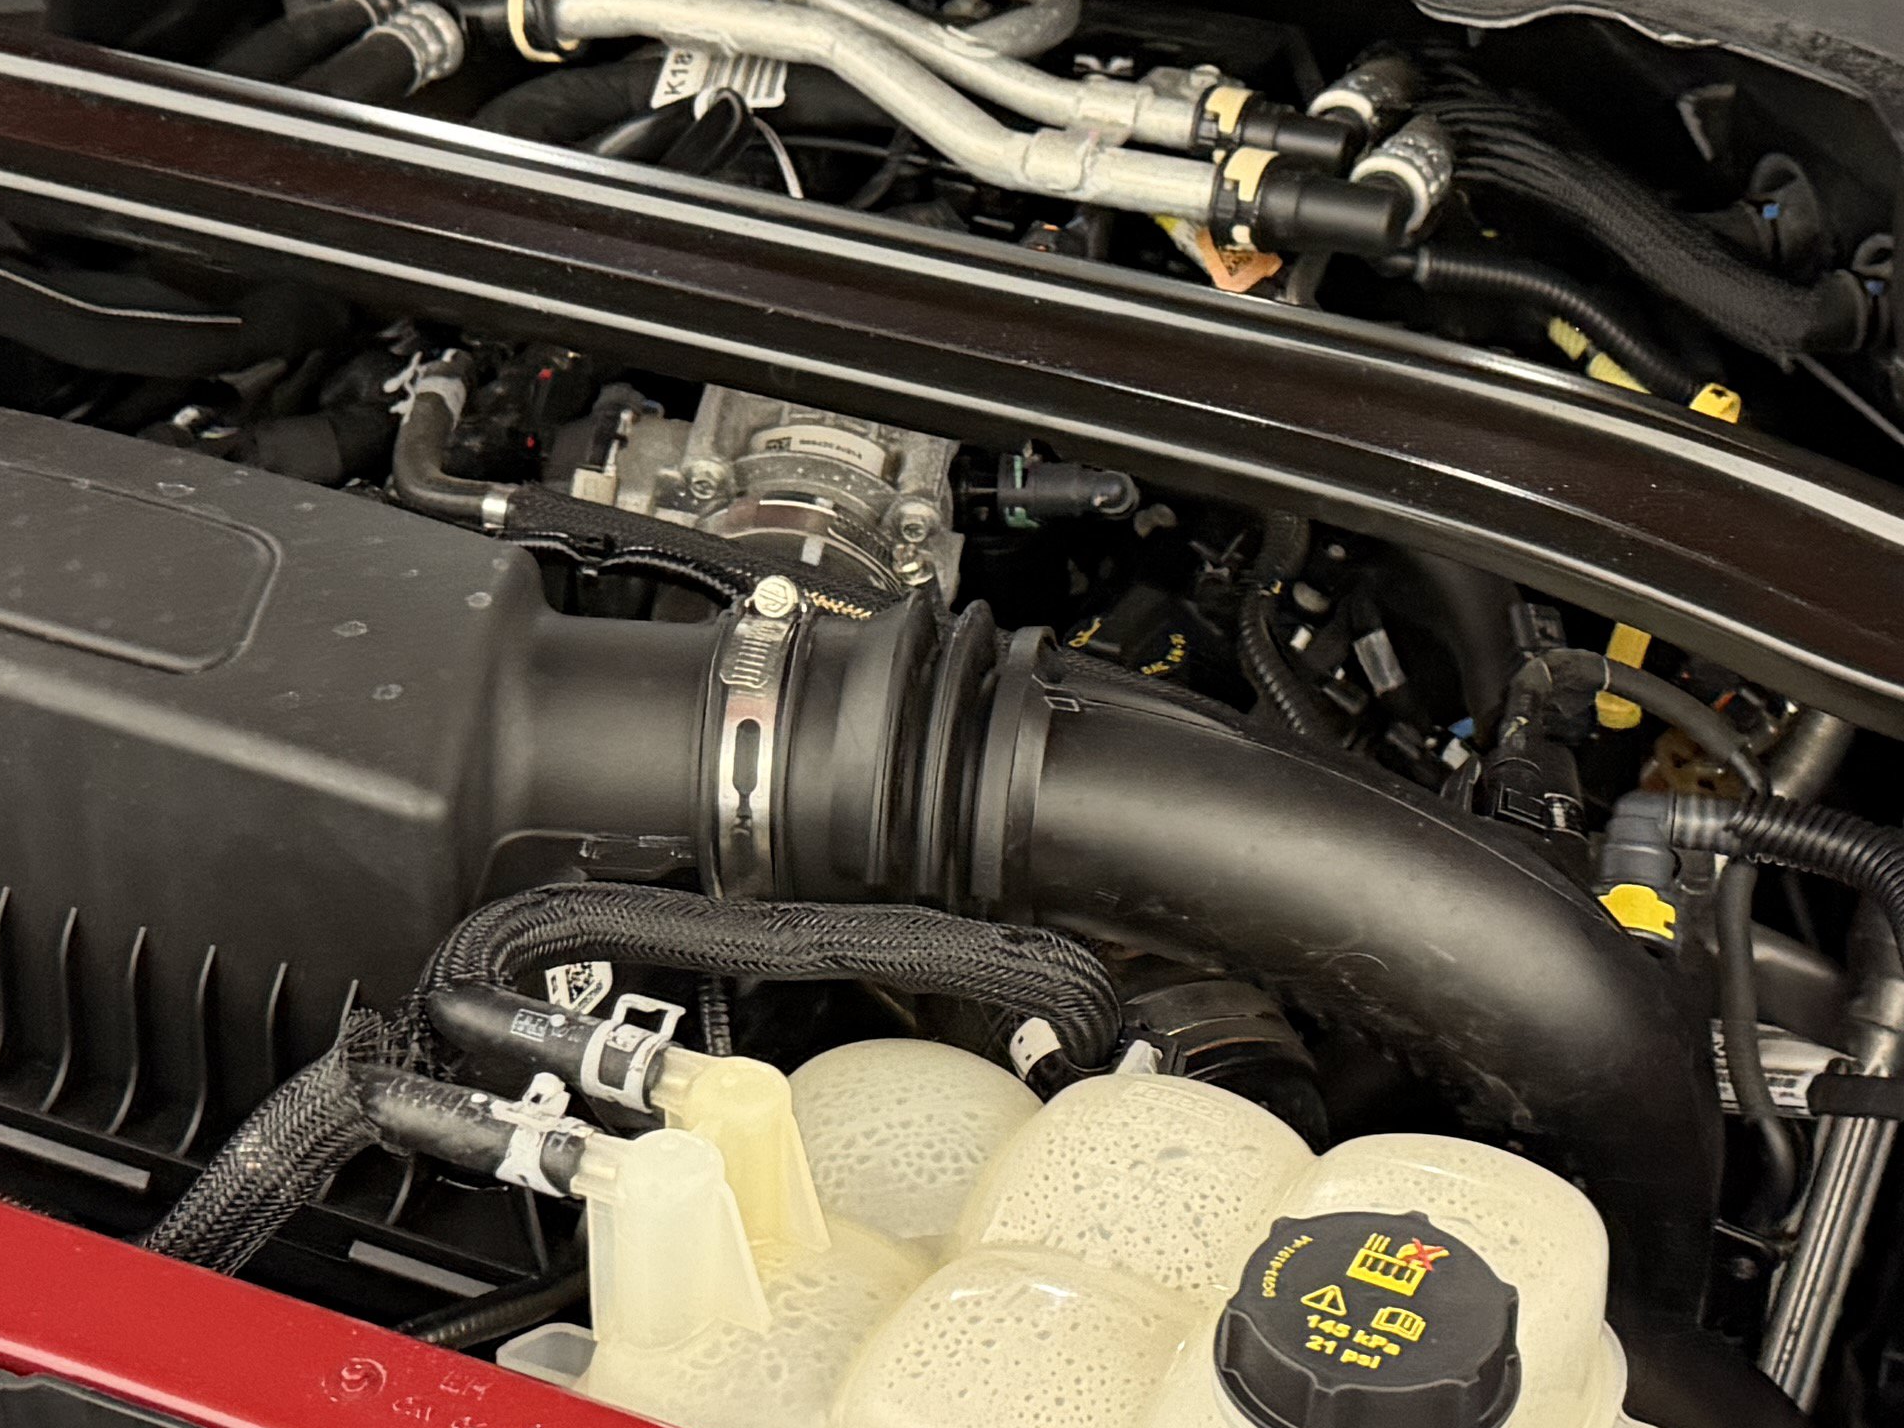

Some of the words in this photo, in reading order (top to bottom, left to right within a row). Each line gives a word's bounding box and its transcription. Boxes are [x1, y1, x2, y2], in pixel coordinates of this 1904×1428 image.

[1305, 1335, 1338, 1355] 21
[1340, 1348, 1382, 1370] psi
[1306, 1314, 1352, 1338] 145
[1352, 1329, 1401, 1356] kPa
